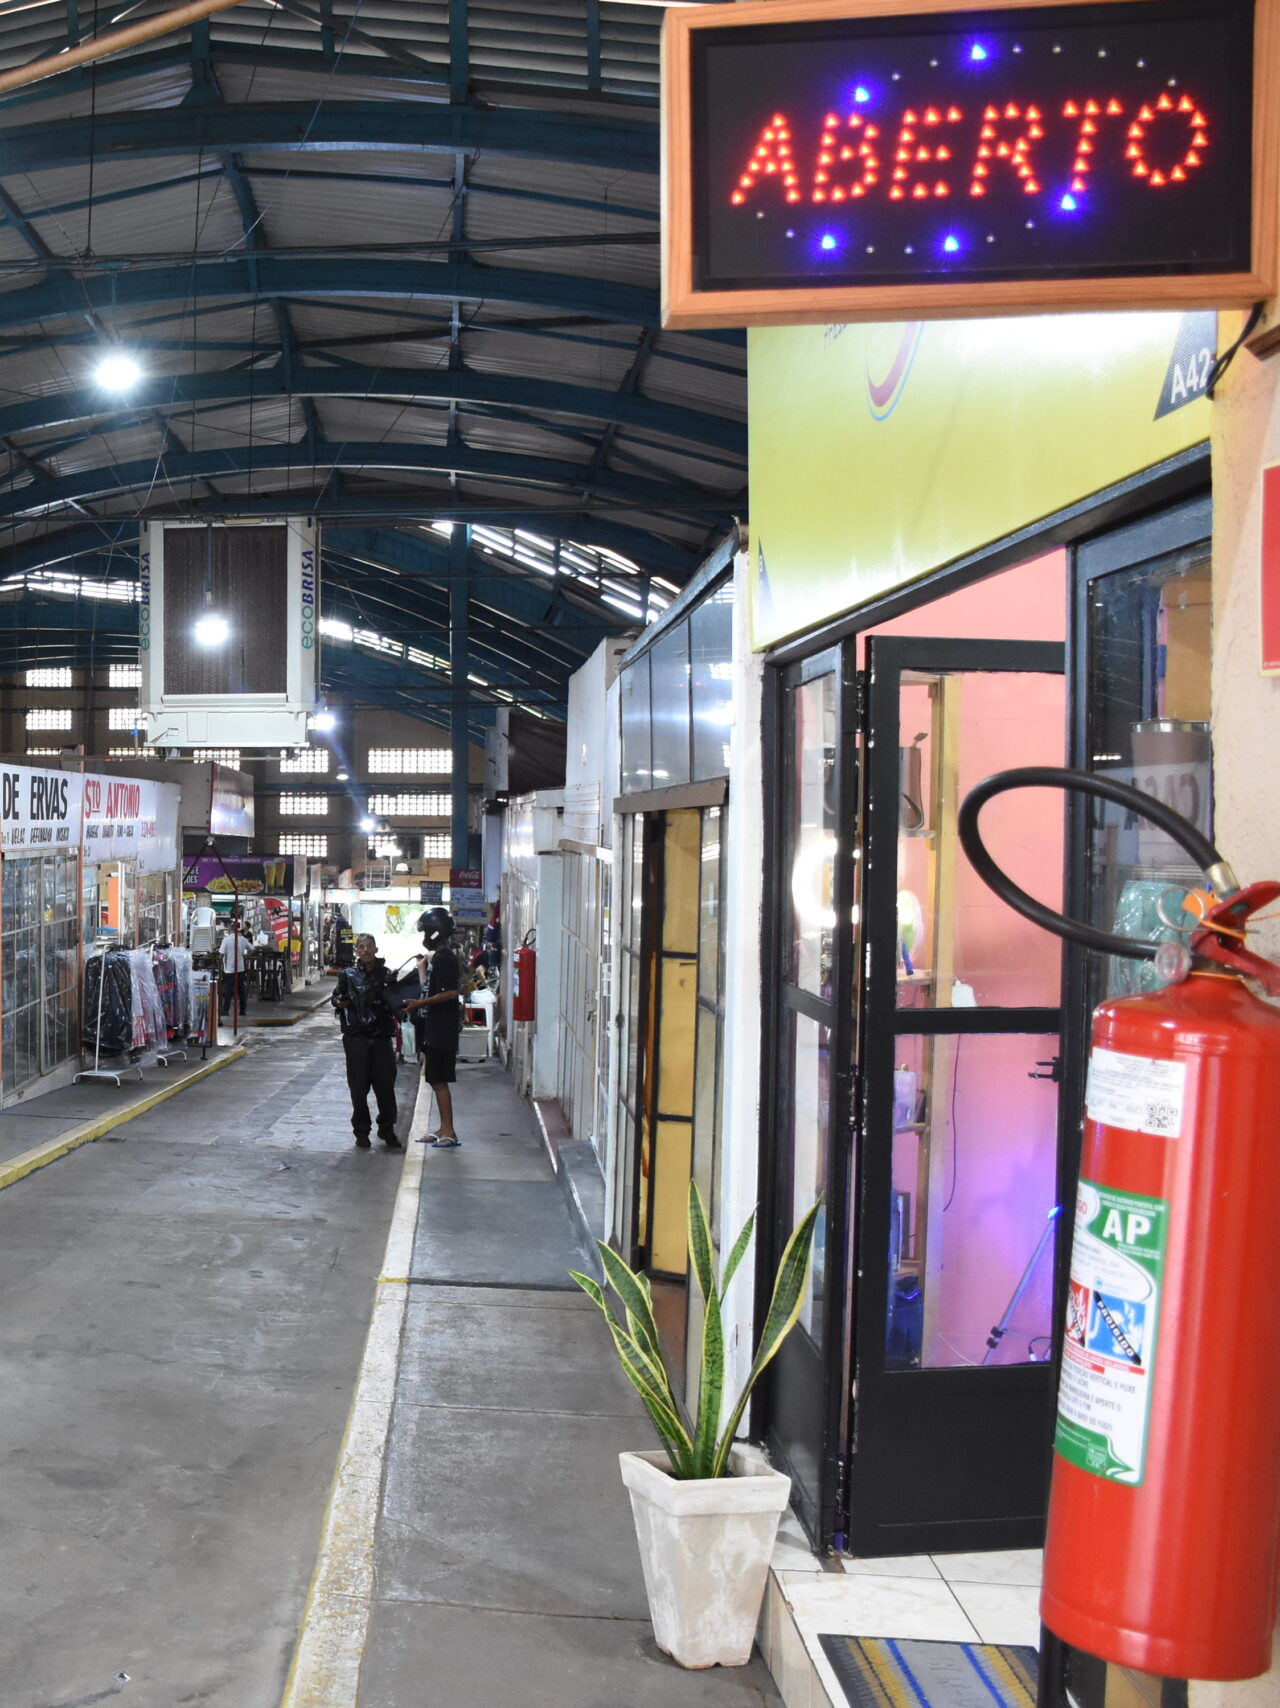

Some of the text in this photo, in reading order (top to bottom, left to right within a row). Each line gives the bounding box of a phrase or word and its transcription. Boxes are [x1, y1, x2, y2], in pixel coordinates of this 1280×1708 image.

[729, 93, 1210, 206] ABERTO
[1170, 347, 1211, 405] A42
[2, 773, 20, 821] DE
[30, 775, 69, 821] ERVAS
[1102, 1208, 1152, 1245] AP
[1096, 1300, 1136, 1357] PROIBIDO
